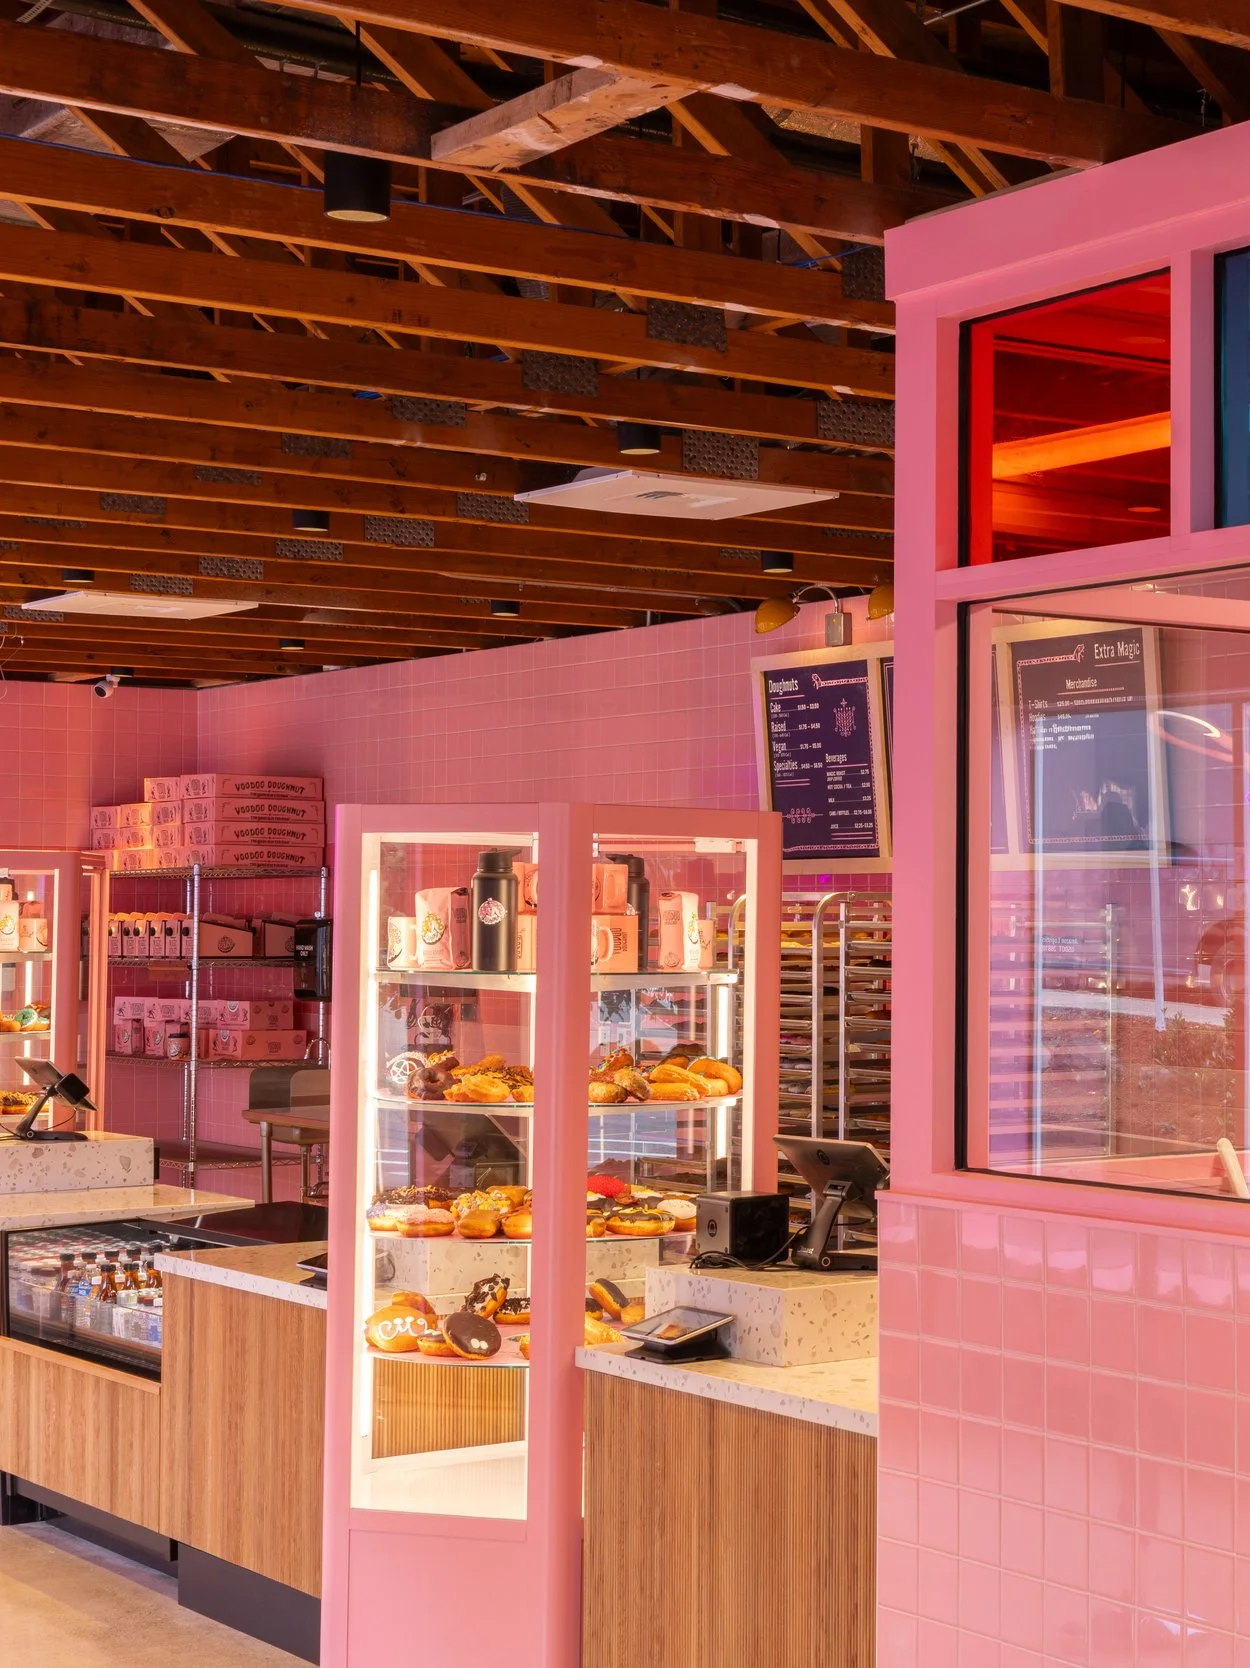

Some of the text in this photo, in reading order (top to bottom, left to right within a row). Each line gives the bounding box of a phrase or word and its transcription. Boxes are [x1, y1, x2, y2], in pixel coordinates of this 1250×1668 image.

[1094, 640, 1140, 660] Extra Magic
[768, 678, 799, 695] Doughnuts
[1065, 677, 1098, 690] Merchandise
[769, 702, 781, 713] Cake
[770, 721, 786, 733] Raised
[772, 740, 787, 754] Vegan
[825, 753, 848, 764] Beverages
[773, 759, 798, 773] Specialties
[234, 781, 265, 792] VOODOO
[267, 780, 306, 795] DOUGHNUT
[234, 804, 307, 818] VOODOO DOUGHNUT
[233, 827, 307, 841] VOODOO DOUGHNUT
[233, 851, 264, 862] VOODOO
[266, 850, 306, 865] DOUGHNUT
